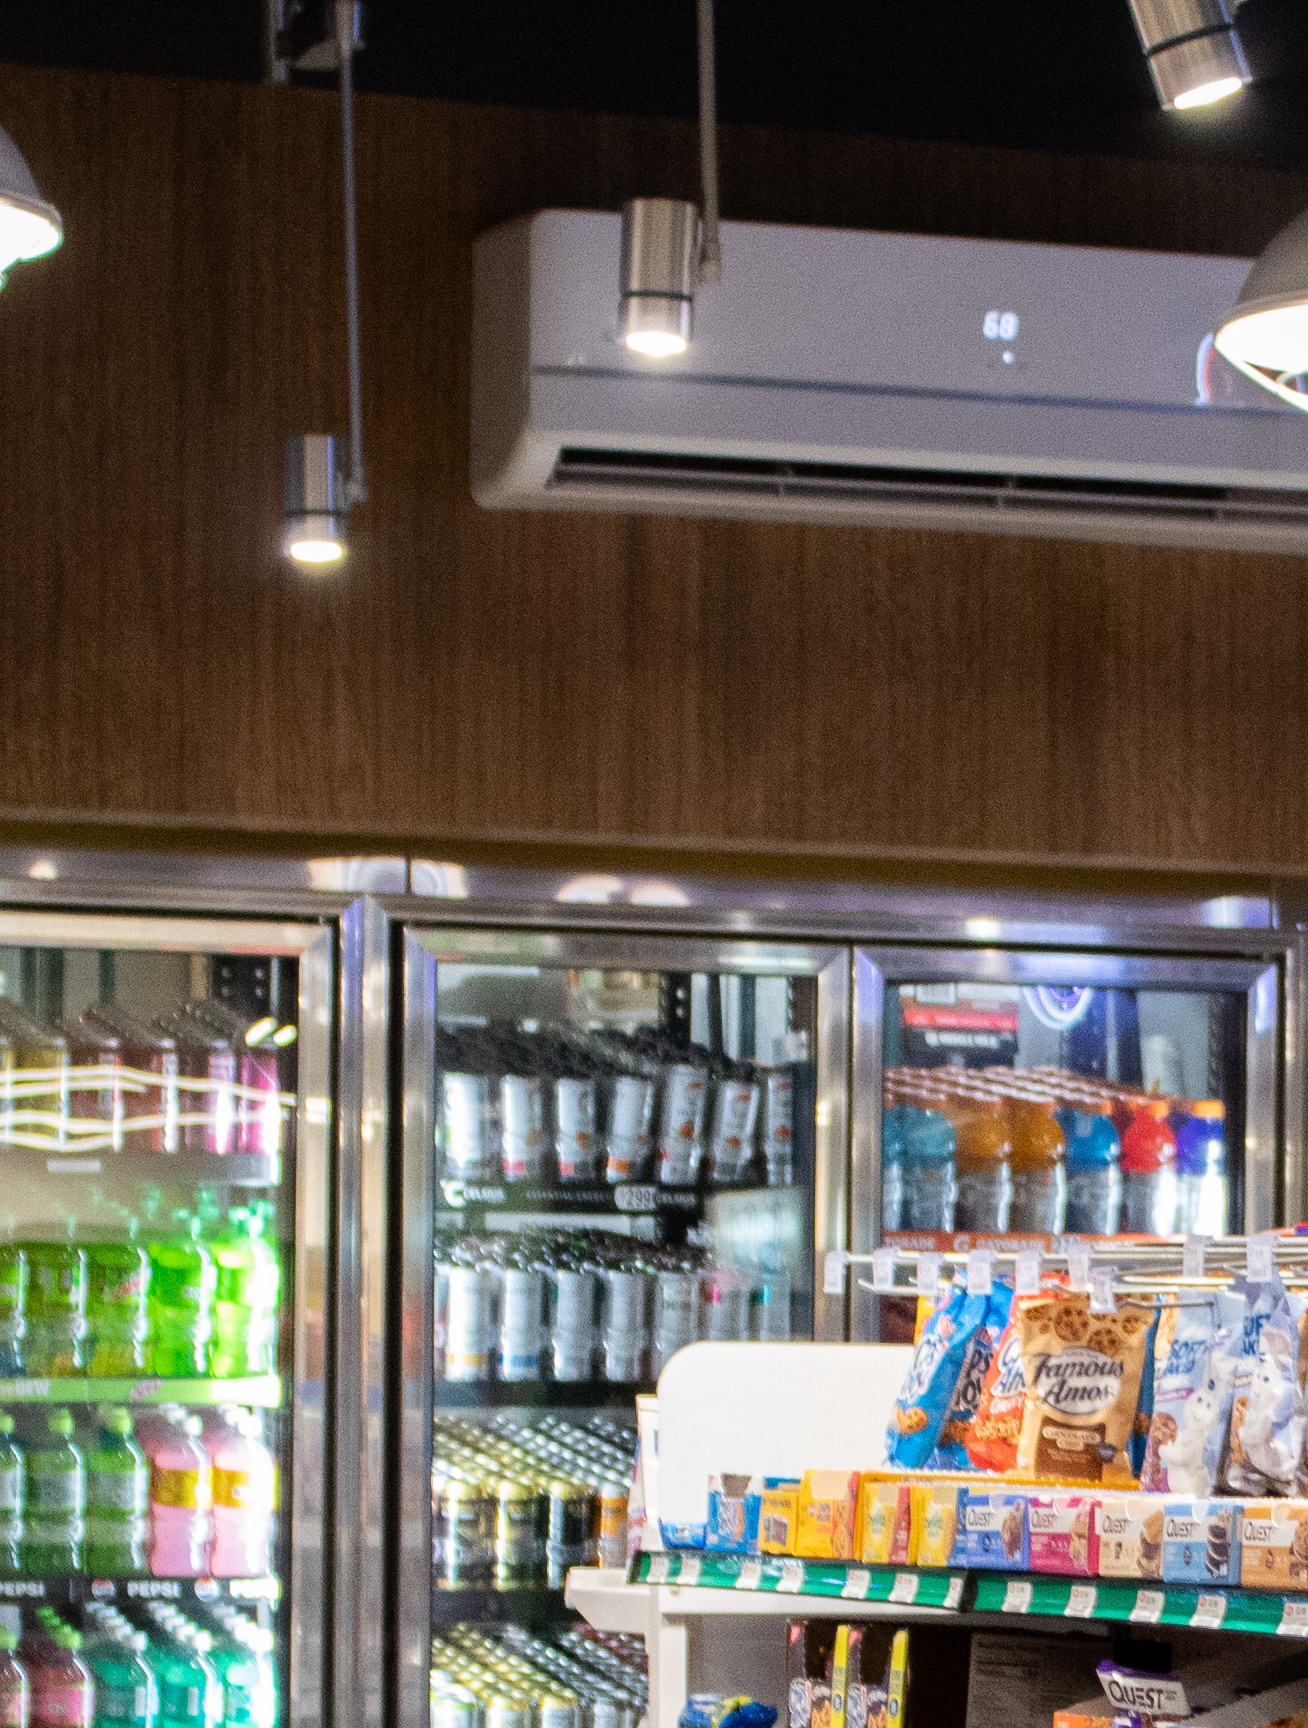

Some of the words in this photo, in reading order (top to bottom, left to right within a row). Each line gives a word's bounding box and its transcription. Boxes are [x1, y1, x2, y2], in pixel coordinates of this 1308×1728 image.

[1031, 1347, 1125, 1382] Famous
[1045, 1374, 1119, 1407] Amos
[127, 1580, 181, 1598] PEPSI
[1107, 1679, 1166, 1711] QUEST
